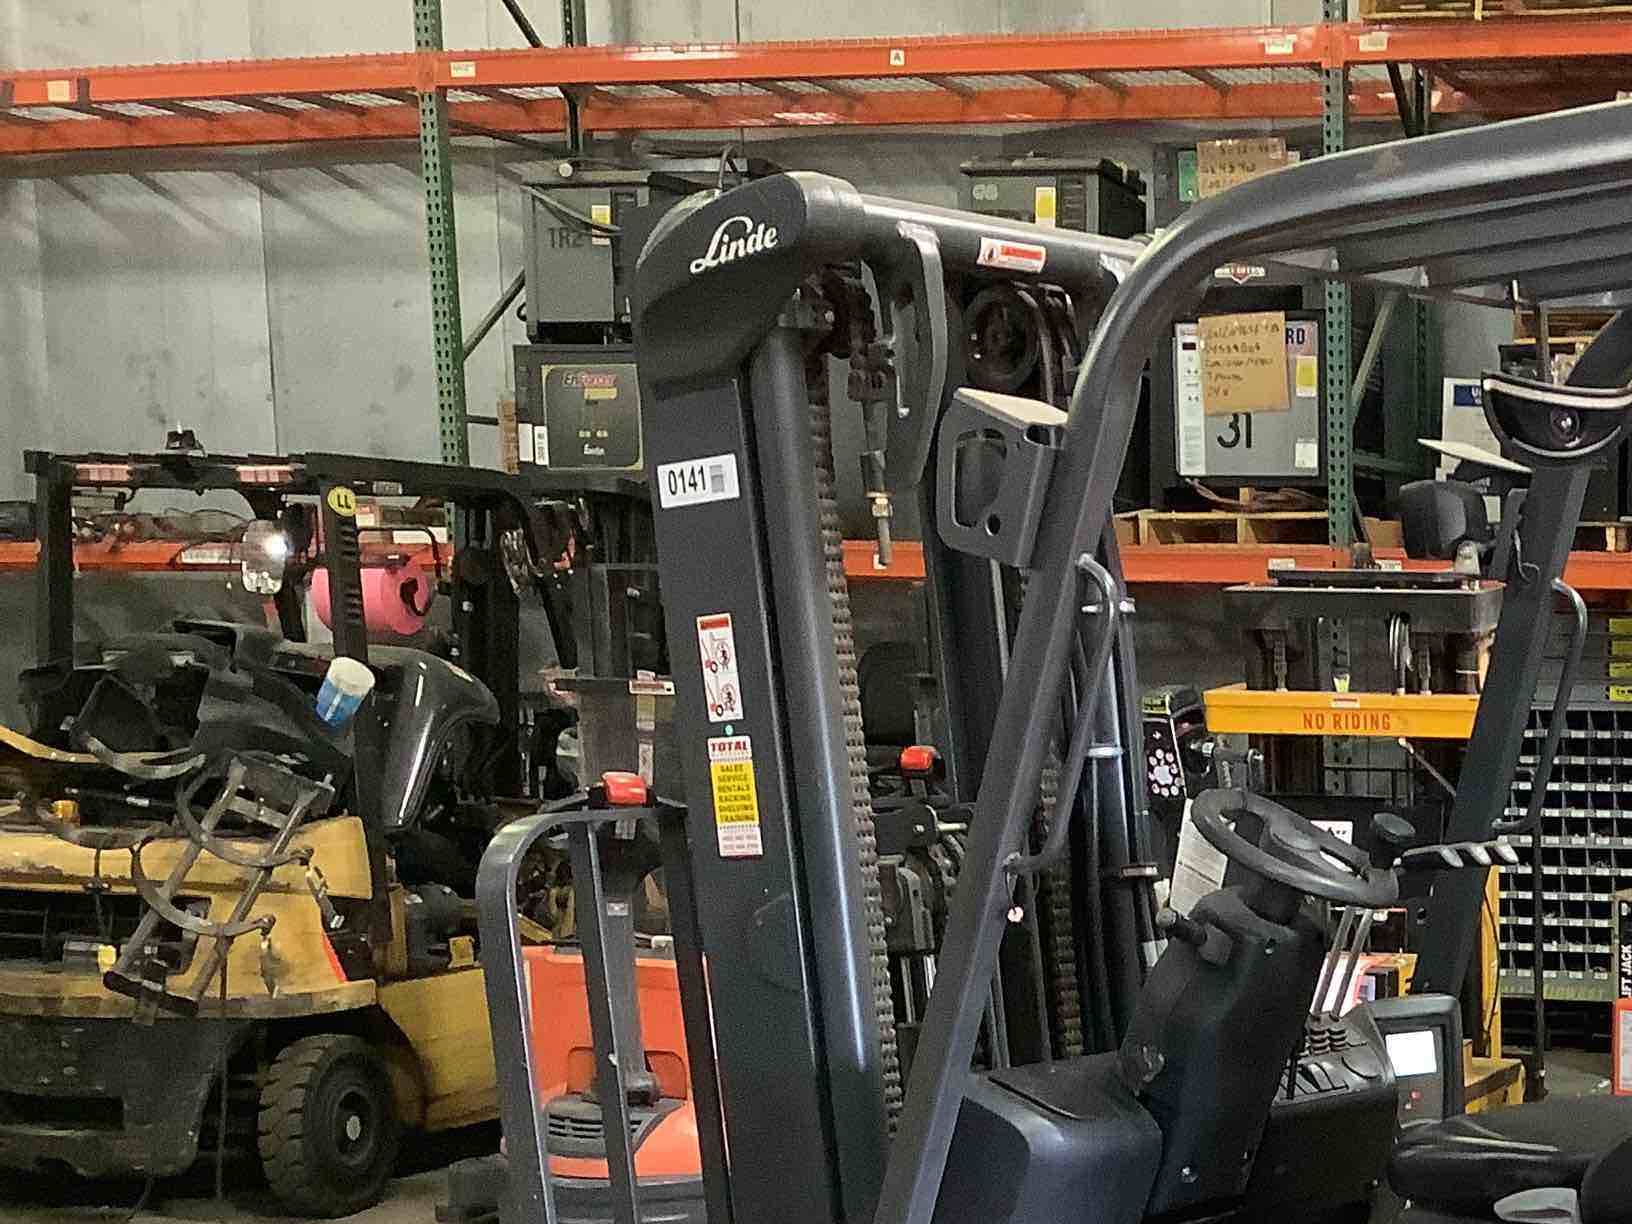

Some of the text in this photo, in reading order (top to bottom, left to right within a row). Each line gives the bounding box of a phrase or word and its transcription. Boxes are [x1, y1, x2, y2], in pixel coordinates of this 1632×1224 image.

[690, 216, 778, 273] Linde
[1217, 412, 1253, 449] 31
[667, 464, 707, 495] 0141
[336, 494, 352, 509] LL
[1303, 712, 1392, 732] NO RIDING
[711, 741, 748, 753] TOTAL
[1621, 944, 1632, 976] JACK
